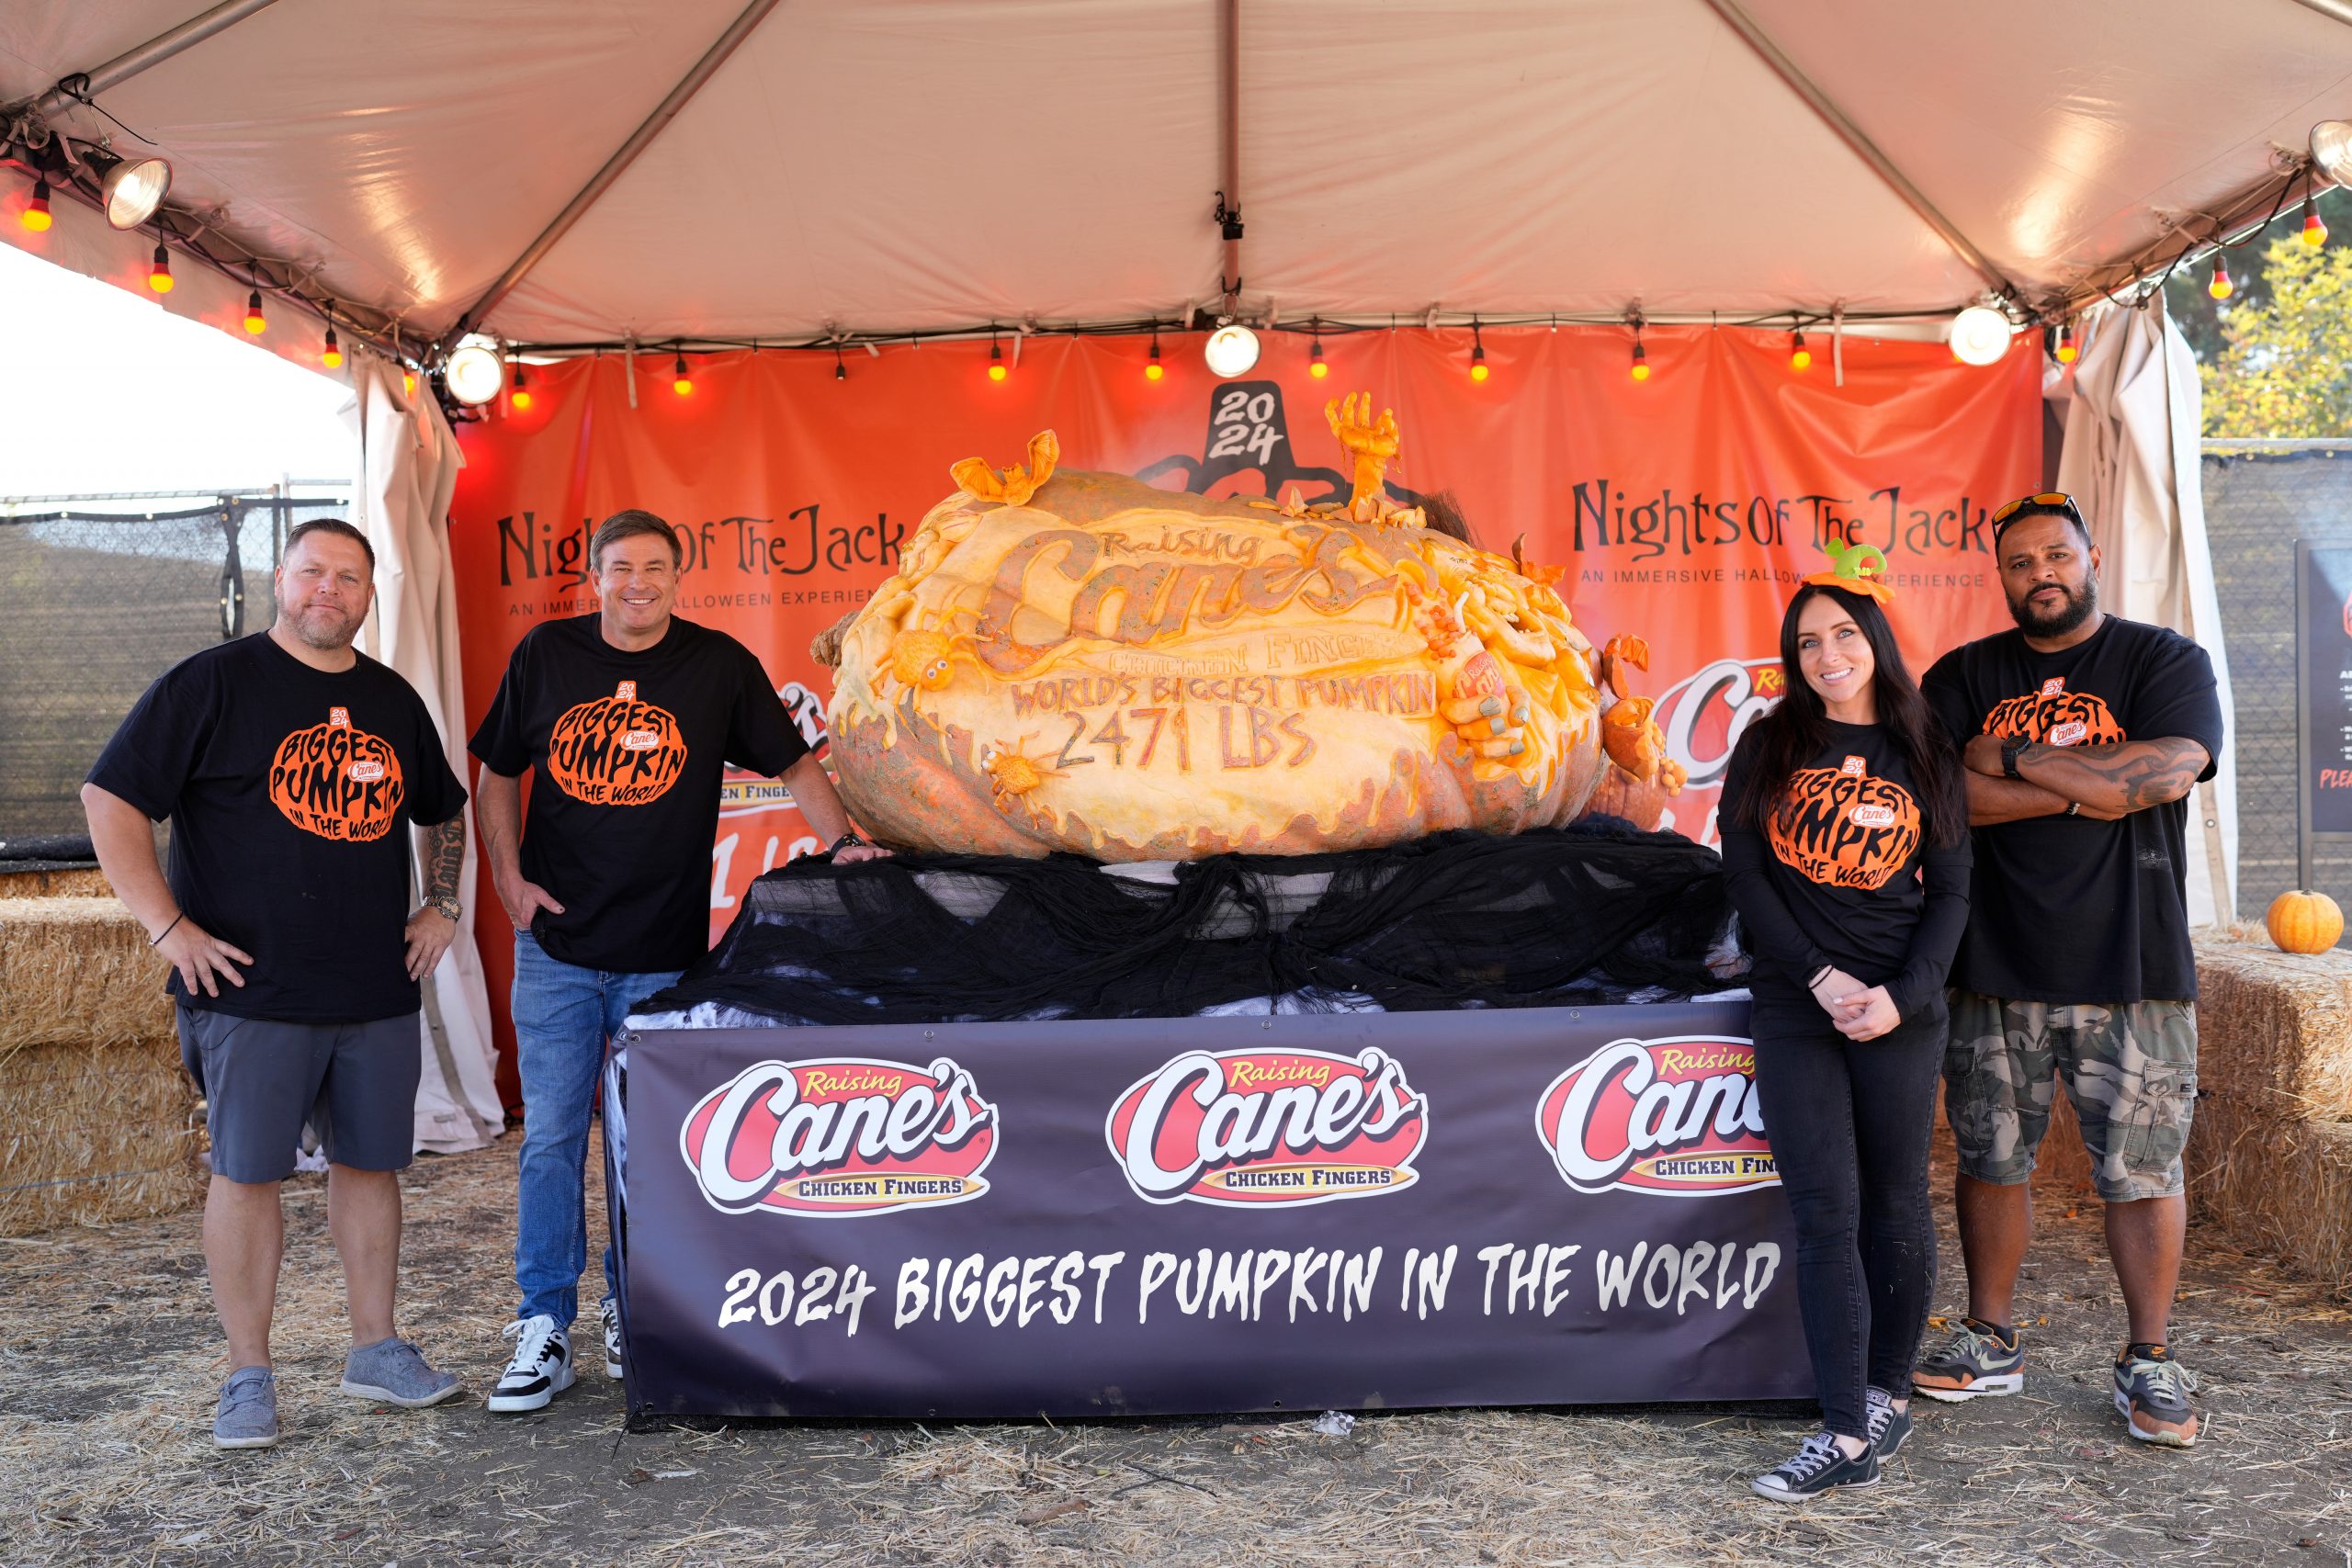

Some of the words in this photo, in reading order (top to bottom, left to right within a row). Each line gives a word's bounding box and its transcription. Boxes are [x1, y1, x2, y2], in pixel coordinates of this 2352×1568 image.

[1214, 390, 1275, 427] 20
[1208, 425, 1283, 466] 24
[1572, 479, 1741, 562] Nights
[1796, 495, 1864, 553] The
[1869, 486, 1989, 556] Jack
[498, 512, 594, 593] Nig
[720, 516, 786, 574] The
[781, 503, 903, 575] Jack
[1102, 525, 1261, 567] Raising
[1581, 570, 1603, 582] AN
[1614, 570, 1724, 582] IMMERSIVE
[1736, 569, 1805, 584] HALLOW
[1872, 574, 1984, 587] XPERIENCE
[509, 603, 533, 615] AN
[543, 599, 602, 614] IMMER
[672, 594, 771, 609] ALLOWEEN
[781, 589, 875, 604] EXPERIEN
[616, 691, 635, 701] 24
[619, 682, 634, 691] 20
[1012, 671, 1139, 719] WORLD'S
[1153, 675, 1282, 706] BIGGEST
[1297, 672, 1434, 716] PUMPKIN
[331, 717, 349, 728] 24
[332, 709, 345, 717] 20
[557, 700, 673, 740] BIGGEST
[281, 727, 392, 771] BIGGEST
[1057, 704, 1191, 772] 2471
[1220, 705, 1316, 768] LBS
[550, 732, 684, 784] PUMPKIN
[1841, 766, 1864, 777] 24
[1846, 758, 1863, 767] 20
[274, 761, 402, 818] PUMPKIN
[560, 776, 572, 792] IN
[577, 782, 607, 801] THE
[611, 783, 667, 802] WORLD
[745, 783, 790, 798] FINGE
[289, 808, 305, 826] IN
[310, 814, 342, 836] THE
[1777, 798, 1918, 867] UMPKIN
[1775, 841, 1791, 861] IN
[1795, 852, 1829, 879] THE
[1835, 865, 1894, 886] WORLD
[1229, 1059, 1330, 1088] Raising
[1659, 1049, 1755, 1076] Raising
[804, 1070, 902, 1097] Raising
[1125, 1053, 1424, 1191] Cane's
[1556, 1043, 1767, 1180] Can
[700, 1063, 996, 1201] Cane's
[1226, 1171, 1305, 1187] CHICKEN
[1312, 1169, 1391, 1186] FINGERS
[1656, 1159, 1735, 1176] CHICKEN
[799, 1179, 876, 1198] CHICKEN
[885, 1179, 962, 1196] FINGERS
[718, 1265, 876, 1337] 2024
[895, 1251, 1125, 1329] BIGGEST
[1139, 1246, 1383, 1324] PUMPKIN
[1401, 1245, 1458, 1321] IN
[1477, 1242, 1581, 1317] THE
[1597, 1240, 1781, 1315] WORLD
